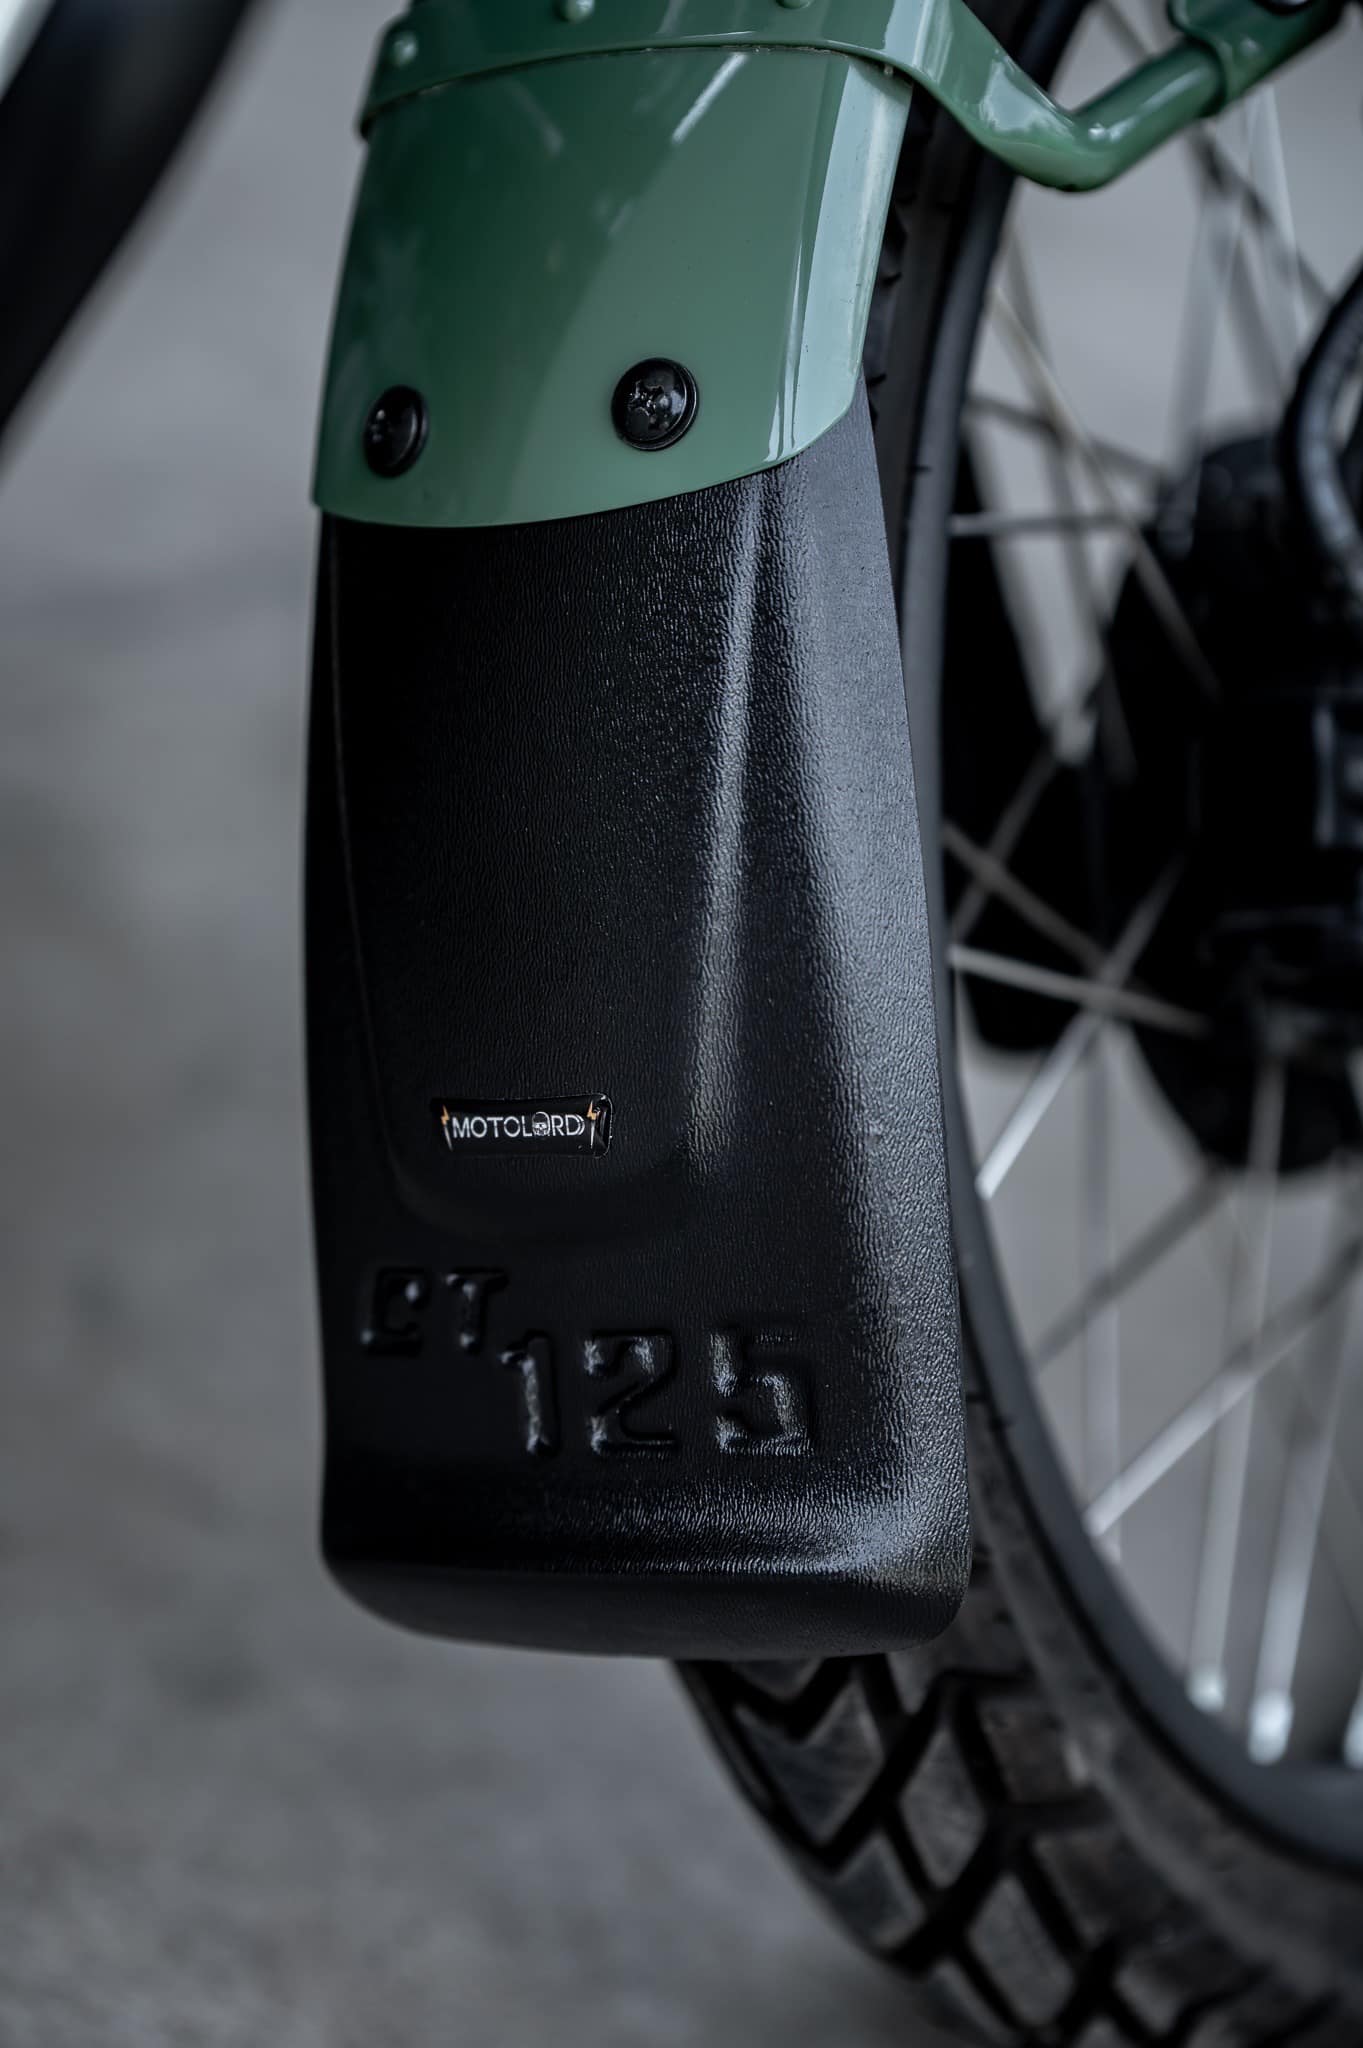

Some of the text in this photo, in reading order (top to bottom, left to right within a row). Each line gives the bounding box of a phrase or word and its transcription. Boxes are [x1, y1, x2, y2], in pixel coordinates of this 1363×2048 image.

[453, 1111, 586, 1139] MOTOLORD
[359, 1267, 509, 1355] CT
[498, 1324, 815, 1456] 125
